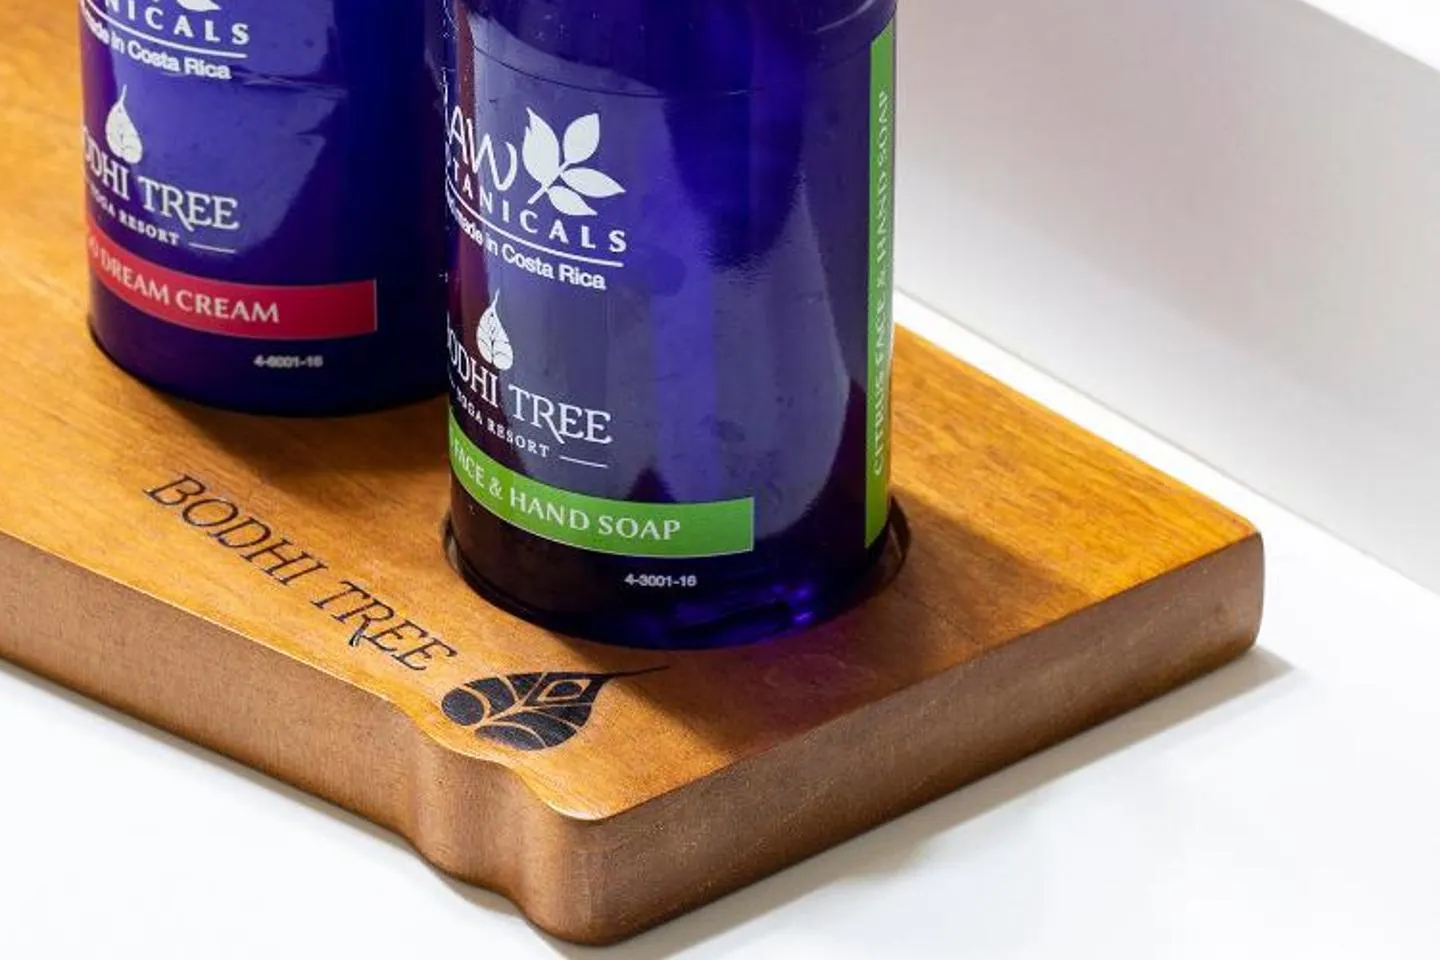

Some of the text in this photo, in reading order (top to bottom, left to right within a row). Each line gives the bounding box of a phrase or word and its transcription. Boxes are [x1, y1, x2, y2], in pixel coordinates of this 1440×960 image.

[127, 40, 180, 72] Costa
[183, 56, 232, 80] Rica
[84, 126, 241, 232] ODHI TREE
[449, 105, 518, 191] AW
[118, 209, 180, 246] RESORT
[451, 156, 627, 253] TANICALS
[100, 247, 281, 326] DREAM CREAM
[485, 232, 498, 257] in
[501, 243, 554, 280] Costa
[559, 263, 607, 291] Rica
[447, 326, 614, 445] ODHI TREE
[486, 418, 550, 459] RESORT
[453, 438, 681, 540] FACE & HAND SOAP
[143, 473, 457, 672] BODHI TREE
[624, 573, 697, 588] 4-3001-16
